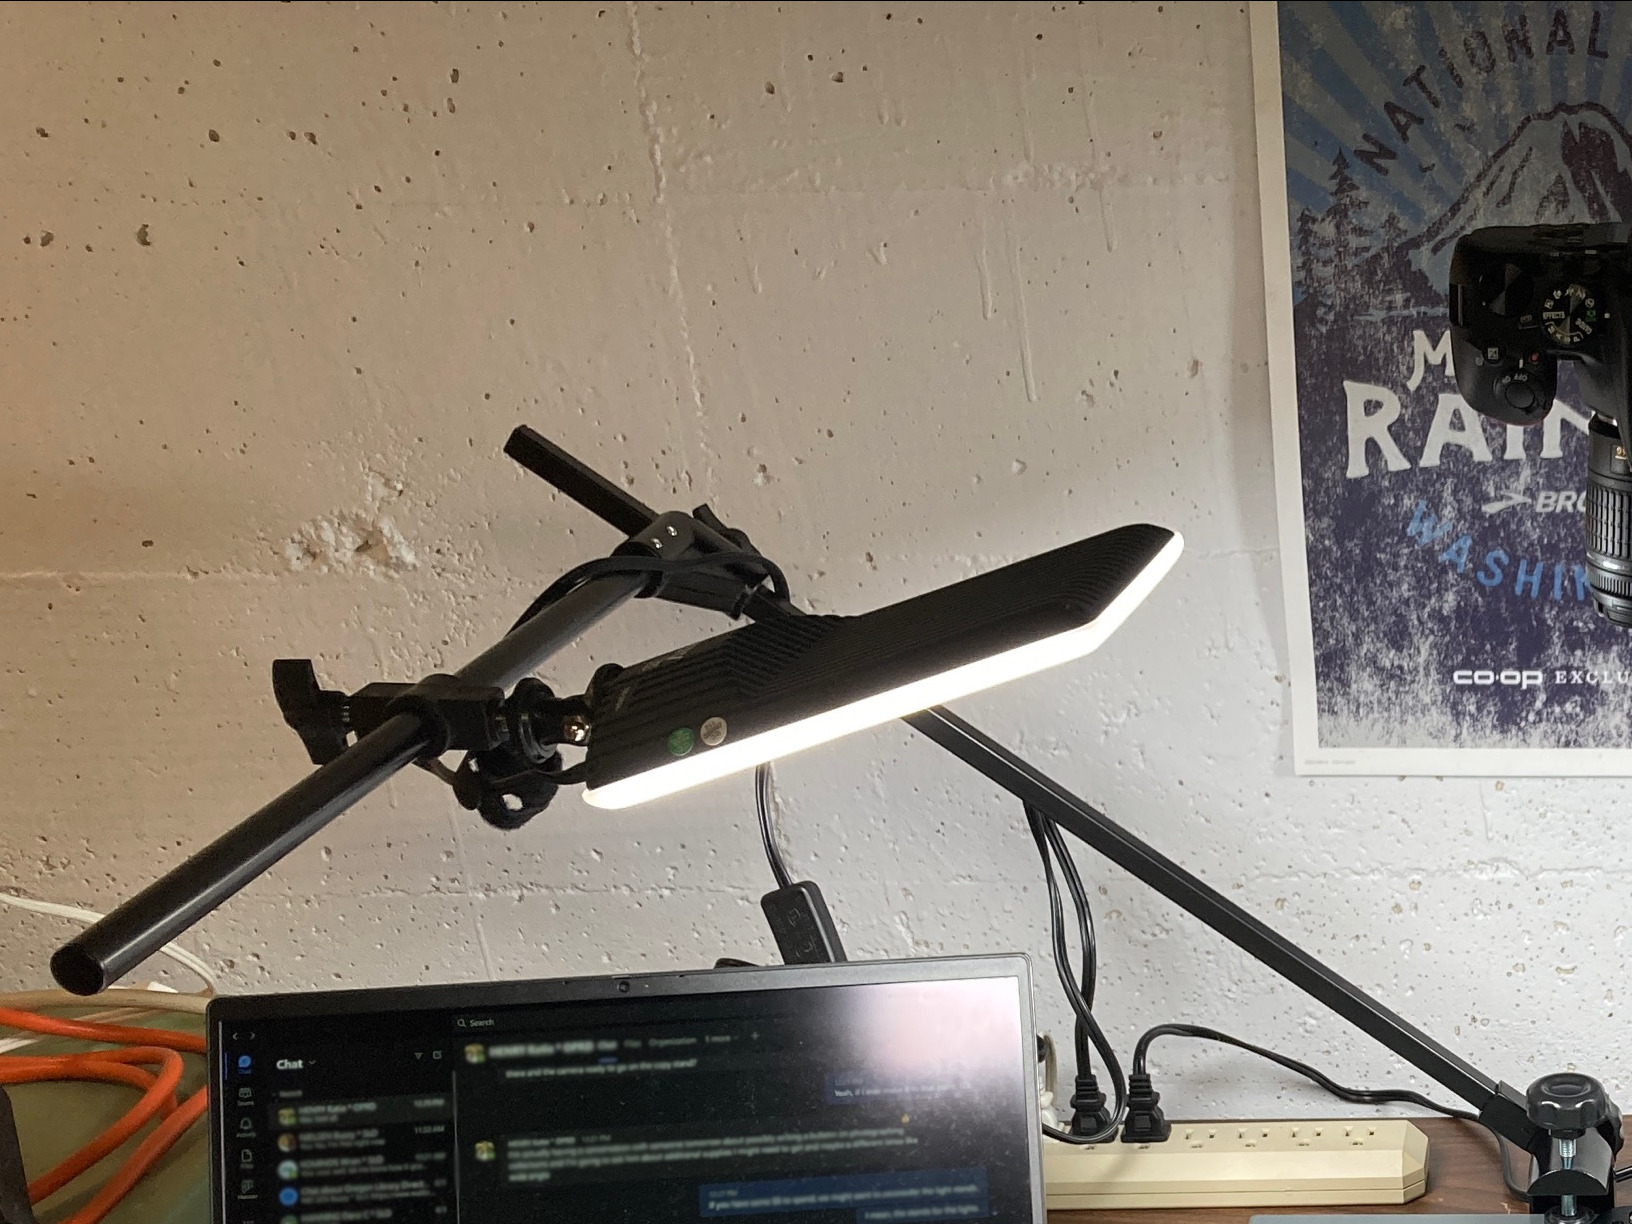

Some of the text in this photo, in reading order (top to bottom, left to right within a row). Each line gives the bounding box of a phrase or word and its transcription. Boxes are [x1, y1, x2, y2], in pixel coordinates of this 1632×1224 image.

[1354, 8, 1611, 176] NATIONAL
[469, 1018, 494, 1027] Search
[276, 1058, 304, 1070] Chat
